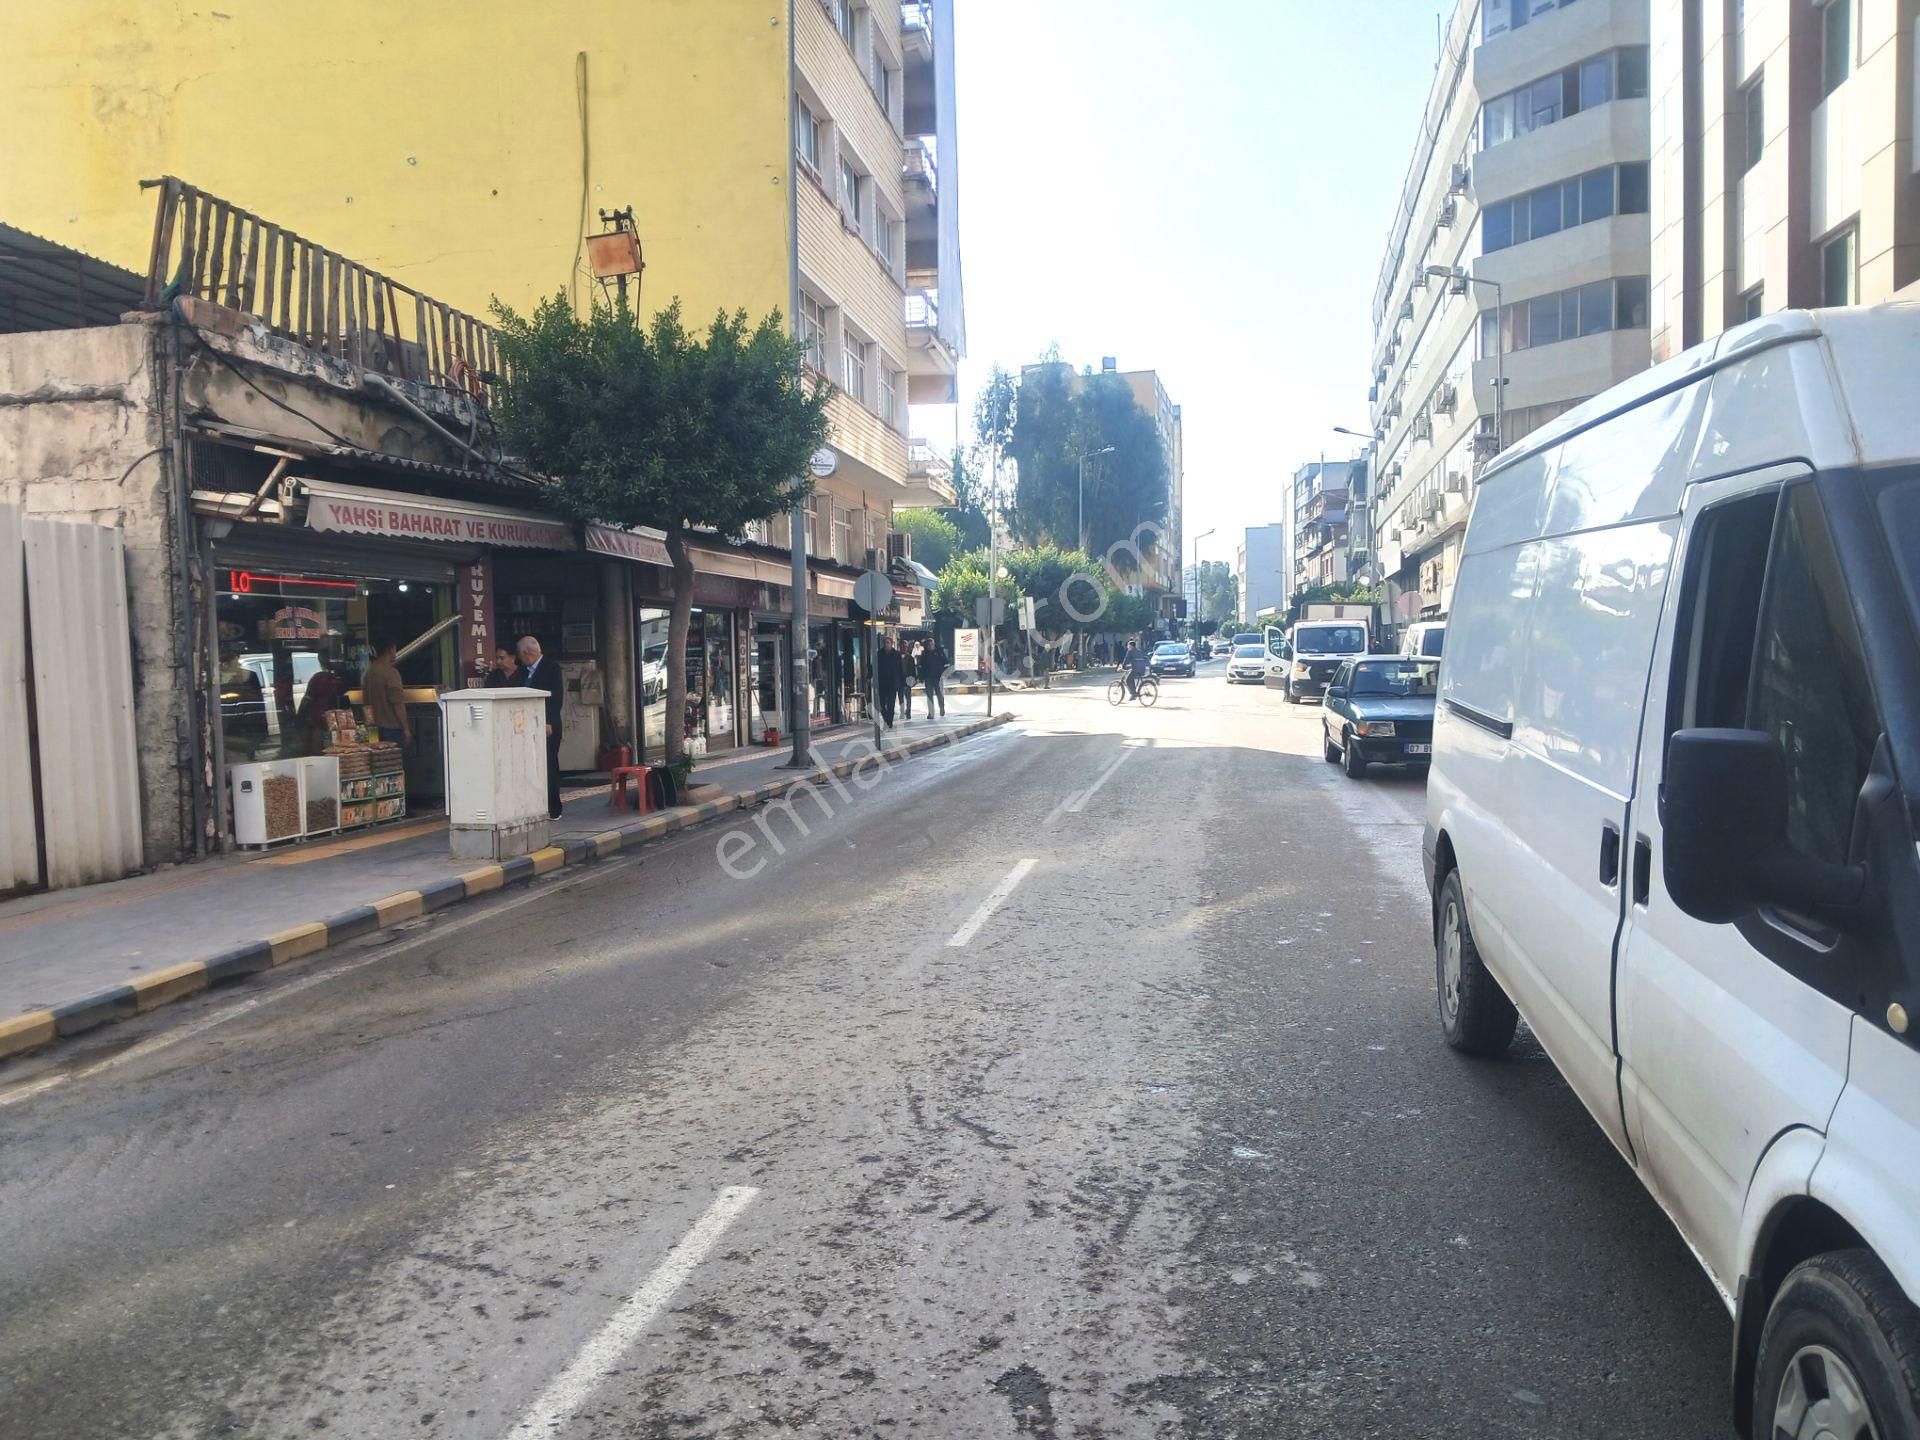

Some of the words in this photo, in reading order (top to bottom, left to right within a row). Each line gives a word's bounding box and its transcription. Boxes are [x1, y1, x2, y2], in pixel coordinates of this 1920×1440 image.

[389, 511, 461, 536] BAHARAT
[467, 521, 484, 539] VE
[471, 563, 487, 674] RUYEMİŞ
[1410, 744, 1420, 753] 07
